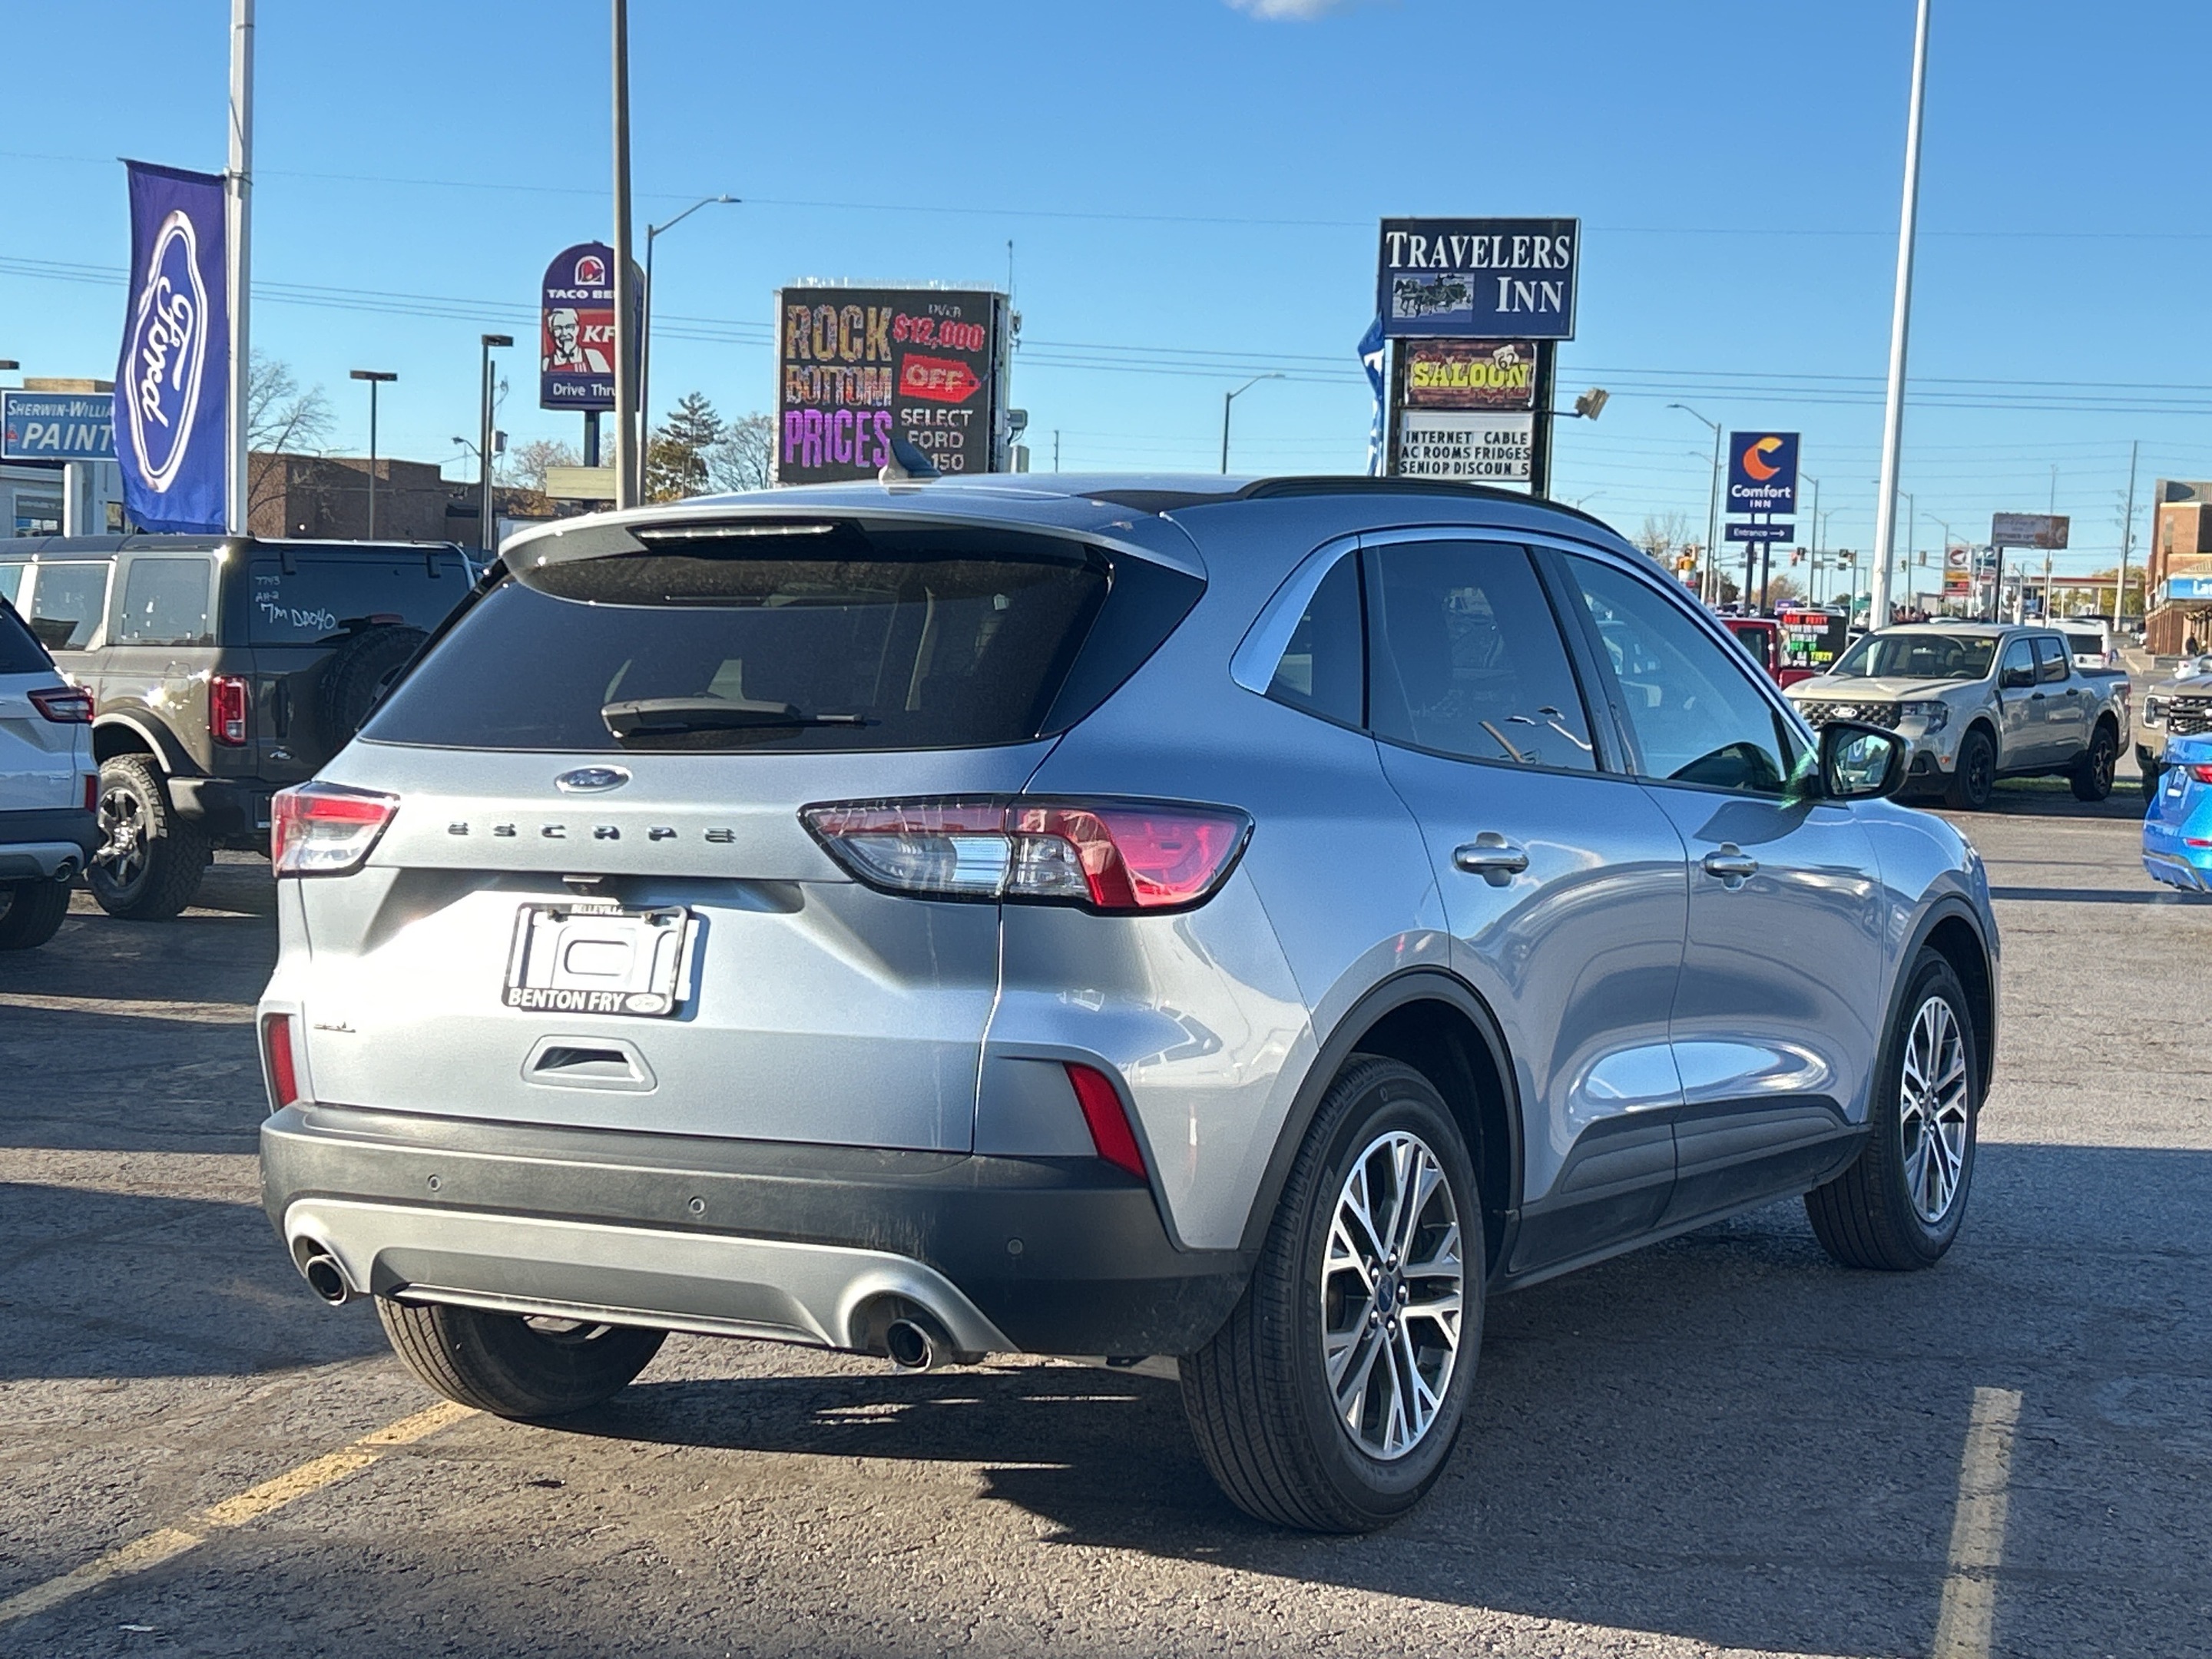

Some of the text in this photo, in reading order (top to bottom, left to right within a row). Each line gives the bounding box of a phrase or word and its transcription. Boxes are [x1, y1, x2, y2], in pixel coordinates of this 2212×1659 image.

[1386, 231, 1571, 270] TRAVELERS
[547, 289, 615, 300] TACO BE
[1495, 276, 1565, 313] INN
[786, 304, 892, 363] ROCK
[892, 313, 985, 353] $12,000
[142, 276, 194, 428] Ford
[1498, 353, 1516, 370] 62
[786, 365, 892, 407] BOTTOM
[906, 364, 964, 392] OFF
[1412, 361, 1529, 389] SALOON
[552, 382, 586, 396] Drive
[901, 409, 973, 427] SELECT
[785, 409, 892, 469] PRICES
[907, 430, 964, 450] FORD
[1406, 431, 1528, 445] INTERNET CABLE
[1402, 447, 1531, 460] AC ROOMS FRIDGES
[1731, 484, 1792, 498] Comfort
[1749, 499, 1772, 508] INN
[448, 822, 736, 843] ESCAPE
[508, 988, 587, 1011] BENTON
[588, 992, 626, 1012] FRY
